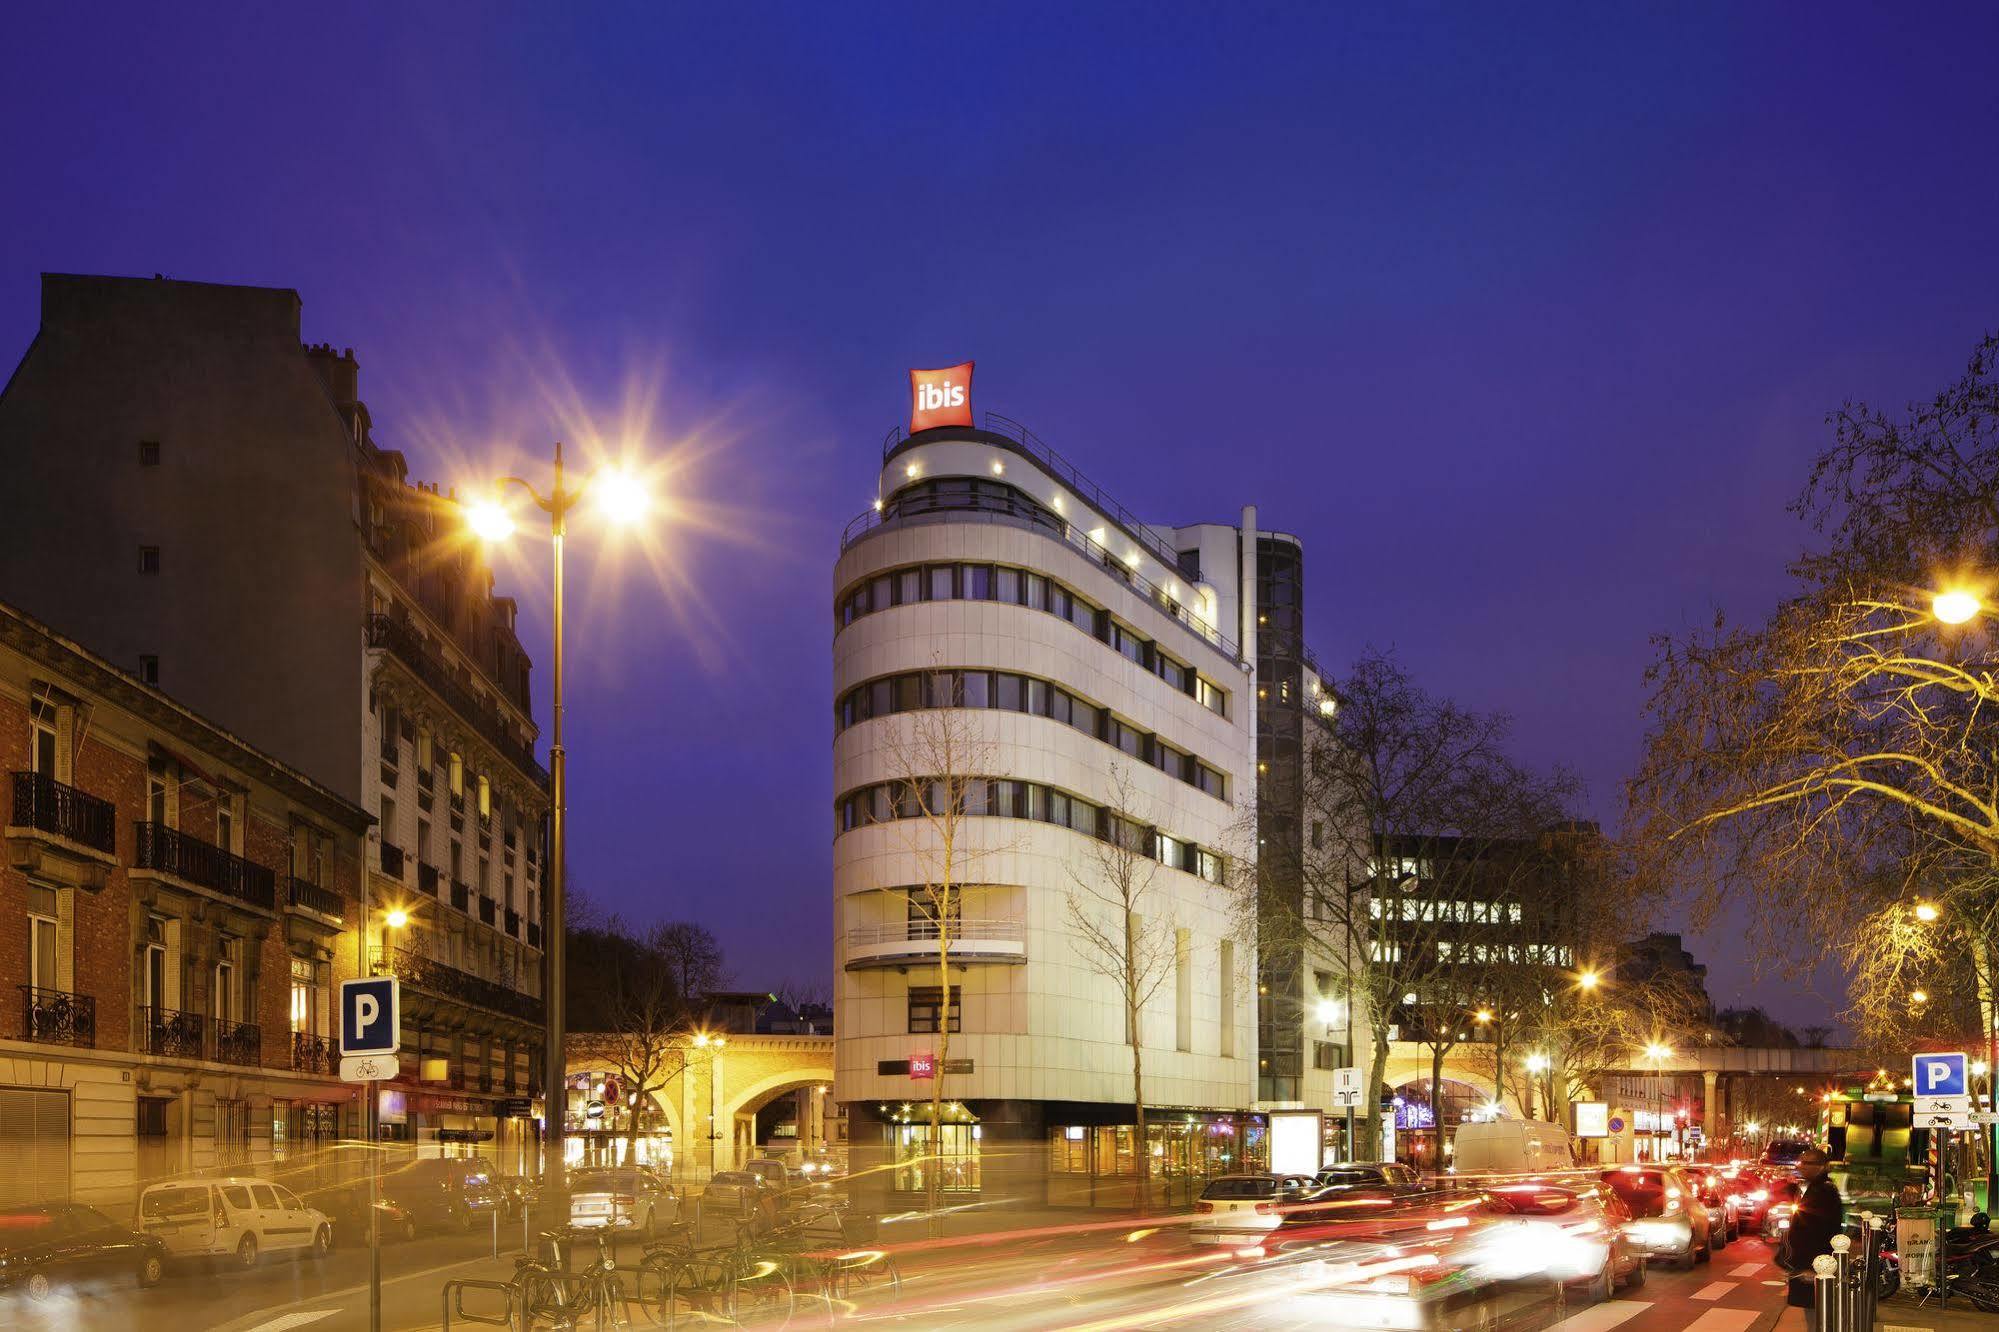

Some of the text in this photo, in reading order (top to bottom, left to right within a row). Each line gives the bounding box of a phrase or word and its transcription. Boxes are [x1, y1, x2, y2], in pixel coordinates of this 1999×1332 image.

[918, 381, 965, 411] ibis
[355, 994, 380, 1040] P
[913, 1061, 931, 1071] ibis
[1927, 1062, 1951, 1090] P
